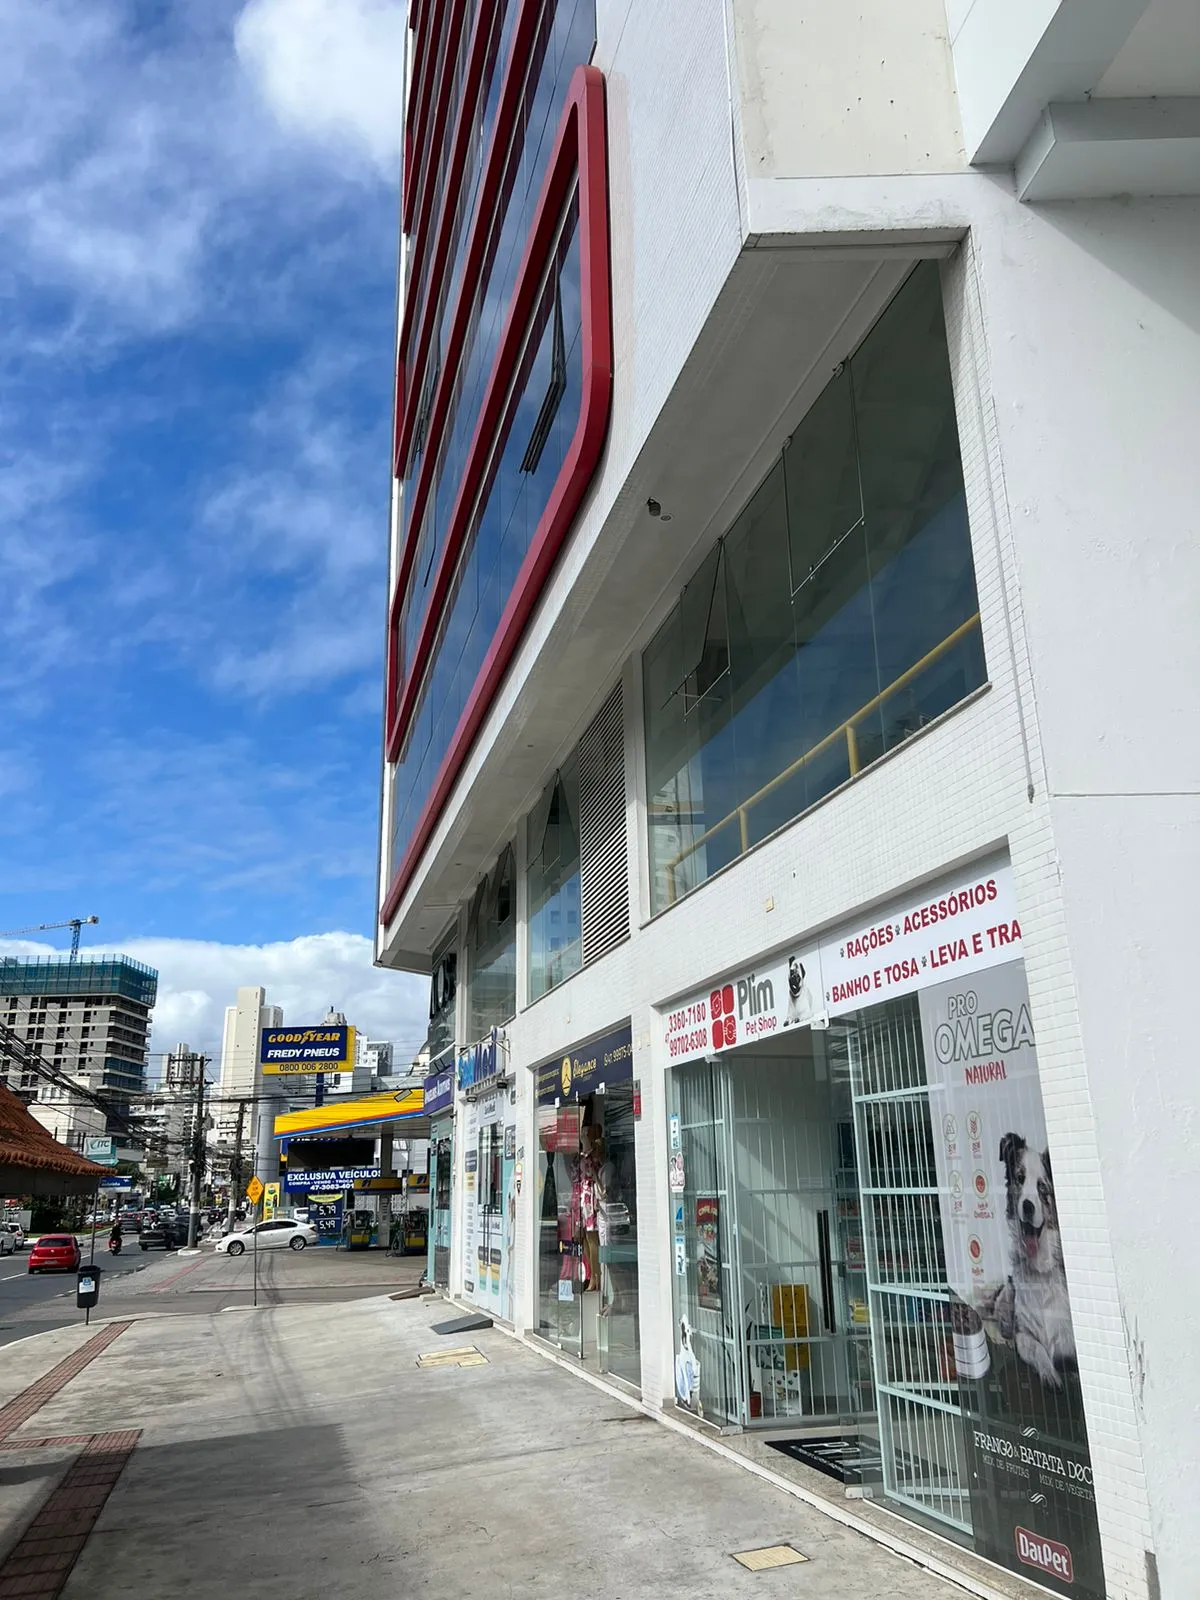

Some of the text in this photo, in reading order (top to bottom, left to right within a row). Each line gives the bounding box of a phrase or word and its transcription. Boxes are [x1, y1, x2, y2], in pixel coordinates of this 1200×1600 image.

[846, 879, 998, 959] RAÇÕES ACESSÓRIOS
[832, 919, 1022, 1003] BANHO E TOSA LEVA E TRA
[737, 973, 774, 1021] Plim
[948, 990, 978, 1020] PRO
[668, 1002, 706, 1033] 3360-7180
[745, 1015, 777, 1036] Pet Shop
[268, 1032, 340, 1043] GOODYEAR
[669, 1028, 707, 1057] 99702-6308
[935, 1003, 1036, 1064] OMEGA
[267, 1047, 340, 1058] FREDY PNEUS
[280, 1062, 338, 1071] 0800 006 2800
[965, 1060, 1007, 1085] NATURAL
[287, 1172, 336, 1182] EXCLUSIVA
[1019, 1445, 1066, 1476] BATATA
